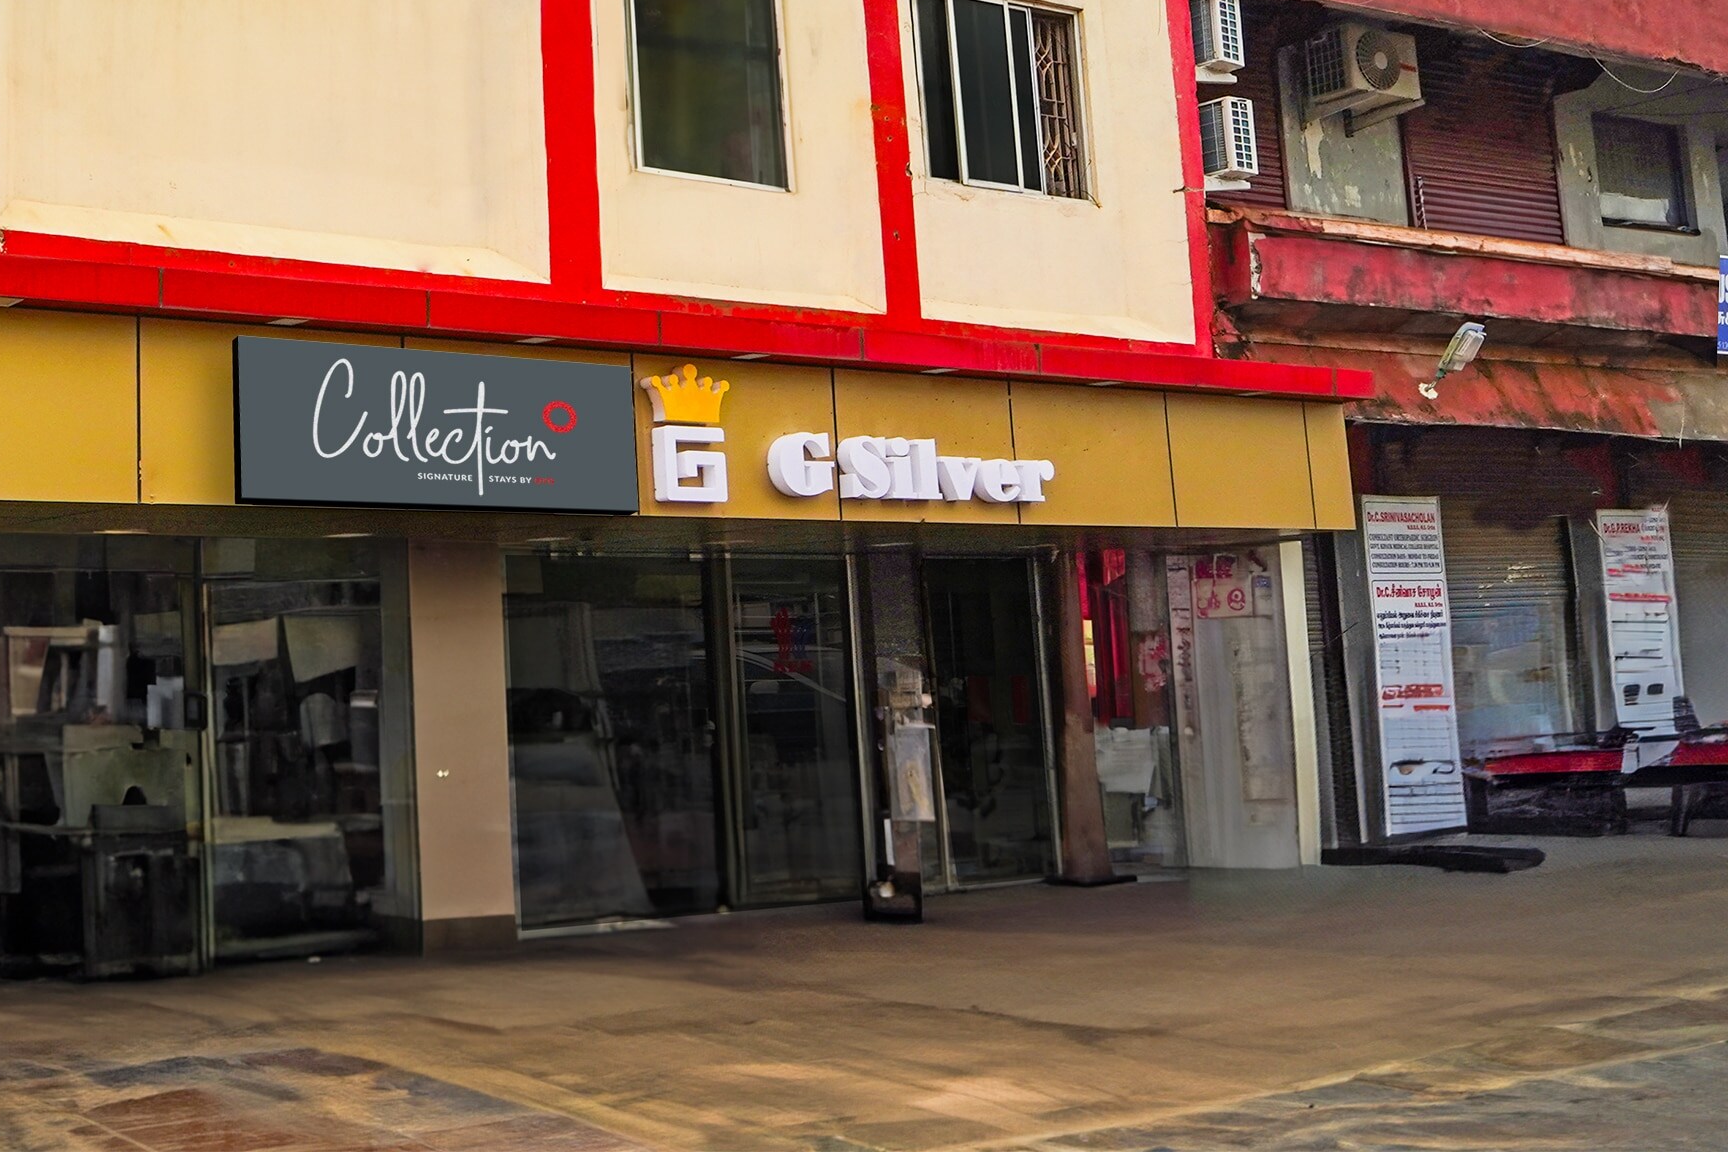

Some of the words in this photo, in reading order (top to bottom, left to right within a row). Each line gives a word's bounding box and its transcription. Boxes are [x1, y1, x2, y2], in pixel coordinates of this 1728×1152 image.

[312, 358, 556, 496] Collection
[417, 472, 473, 482] SIGNATURE
[488, 475, 517, 484] STAYS
[519, 476, 532, 484] BY
